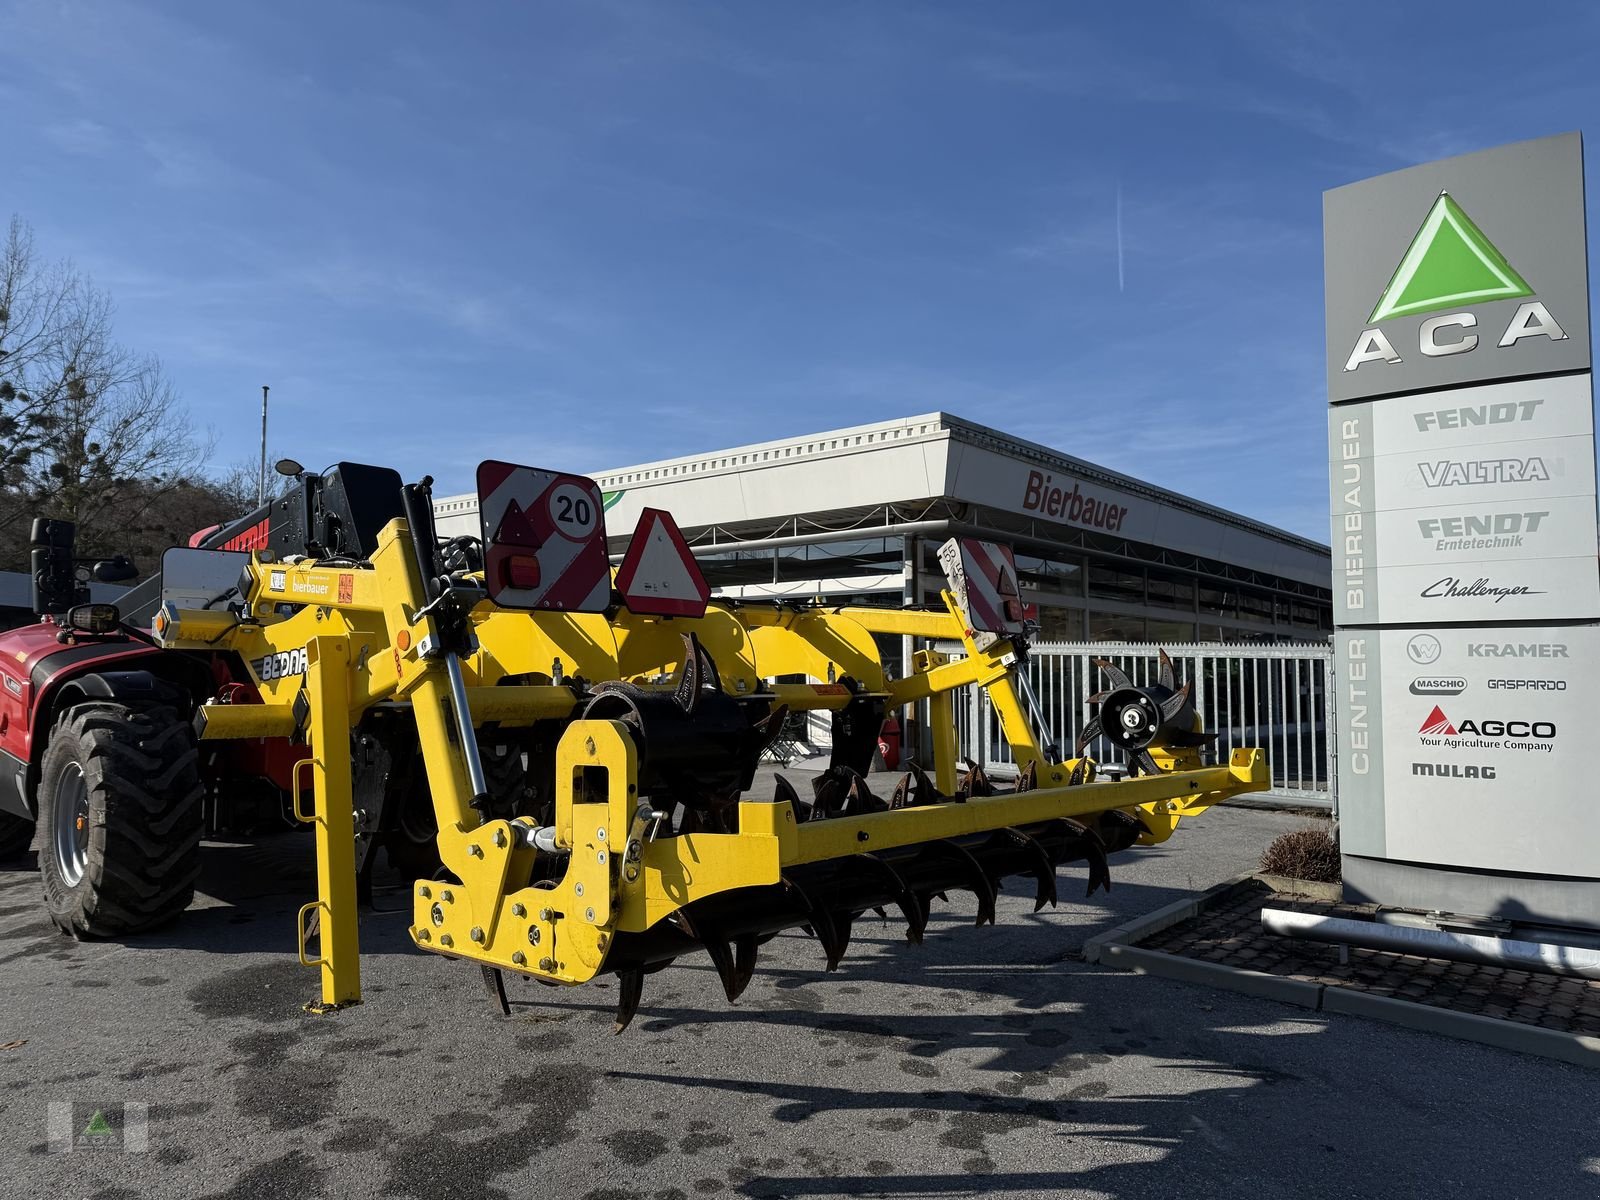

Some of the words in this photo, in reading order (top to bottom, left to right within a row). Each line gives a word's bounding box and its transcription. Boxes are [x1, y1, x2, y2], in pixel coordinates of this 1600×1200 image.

[1343, 301, 1569, 372] ACA
[1413, 399, 1544, 432] FENDT
[1417, 457, 1550, 488] VALTRA
[557, 495, 590, 525] 20
[1023, 470, 1128, 532] Bierbauer
[1342, 418, 1364, 609] BIERBAUER
[1417, 511, 1550, 539] FENDT
[942, 544, 957, 563] 55
[1435, 535, 1524, 551] Erntetechnik
[292, 575, 329, 594] bierbauer
[1420, 577, 1548, 604] Challenger
[262, 647, 308, 680] BEDNA
[1467, 643, 1570, 658] KRAMER
[1417, 679, 1465, 688] MASCHIO
[1487, 679, 1567, 691] GASPARDO
[1348, 639, 1370, 775] CENTER
[1457, 719, 1557, 738] AGCO
[1420, 737, 1441, 747] Your
[1444, 738, 1500, 749] Agriculture
[1504, 740, 1554, 752] Company
